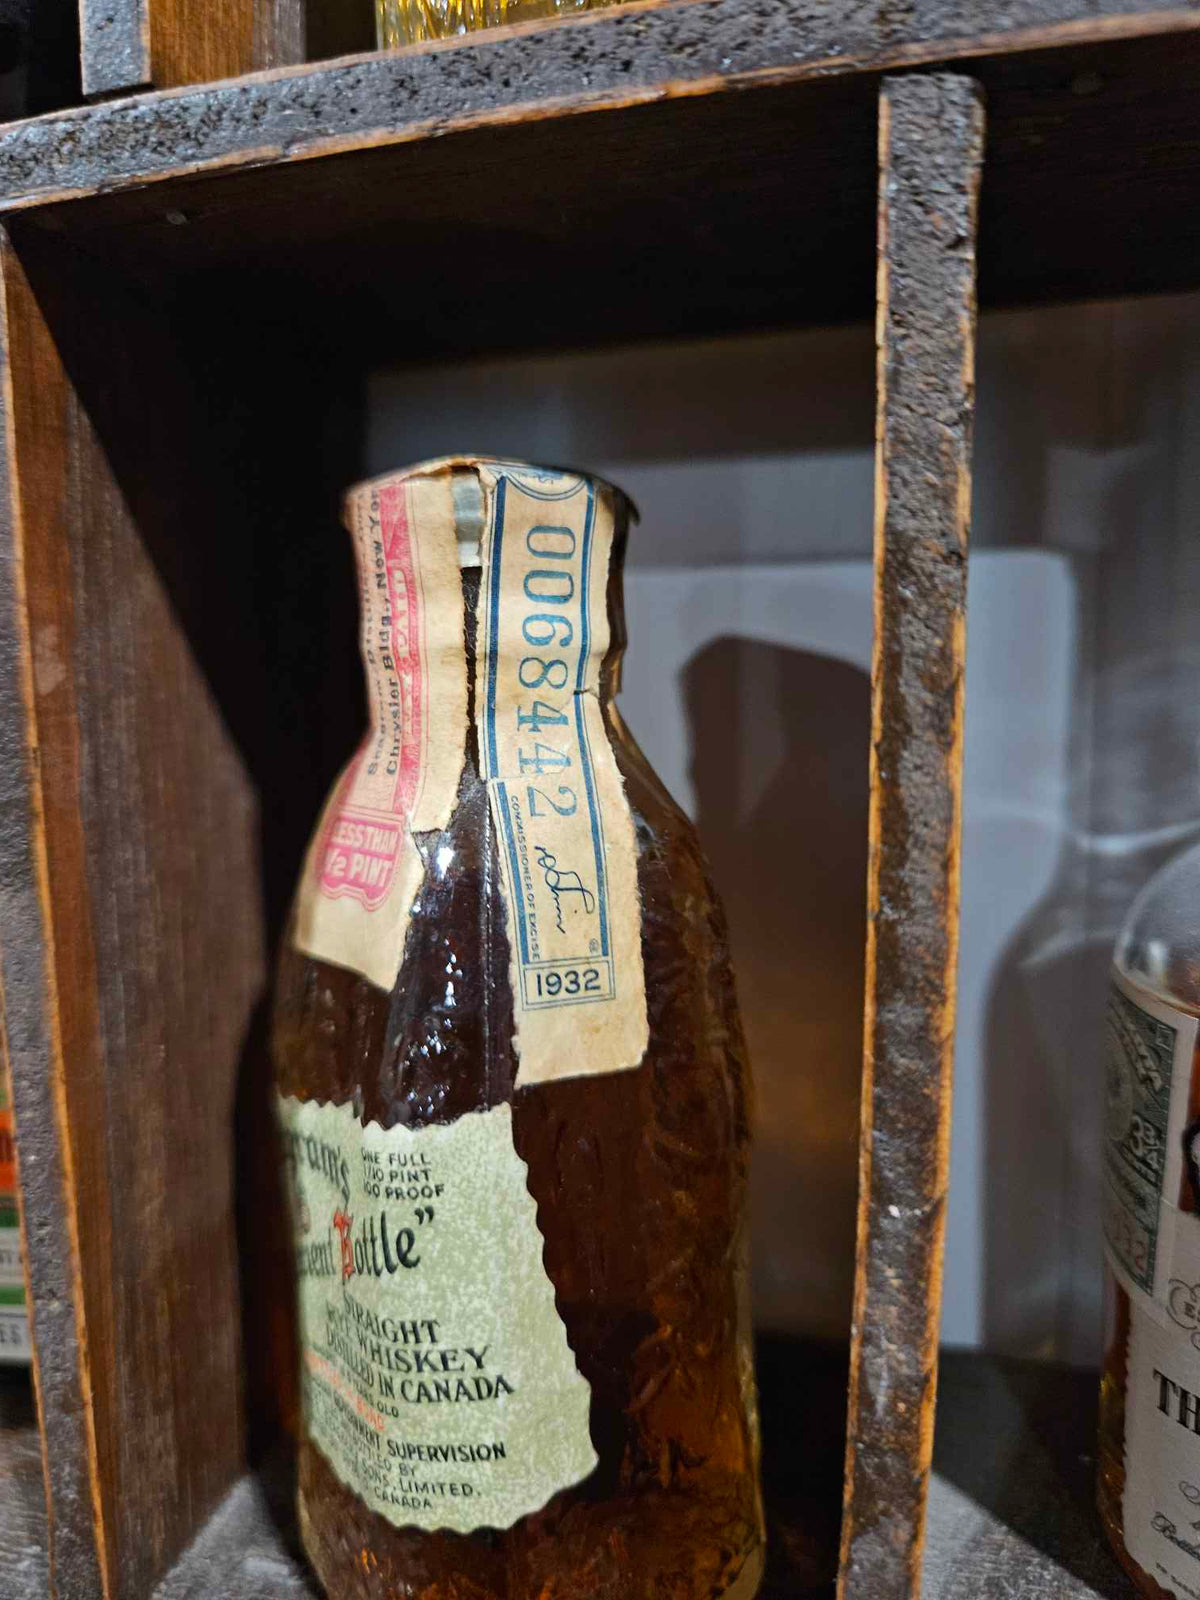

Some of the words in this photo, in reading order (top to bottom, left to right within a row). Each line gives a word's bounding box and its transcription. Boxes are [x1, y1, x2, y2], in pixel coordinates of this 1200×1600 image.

[373, 540, 387, 590] New
[517, 525, 577, 817] 0068442
[511, 795, 532, 891] COMMISSIONER
[350, 852, 394, 888] PINT
[526, 892, 536, 908] OF
[528, 912, 541, 960] EXCISE
[536, 968, 601, 997] 1932
[389, 1153, 433, 1167] FULL
[389, 1169, 432, 1183] PINT
[385, 1183, 445, 1200] PROOF
[343, 1289, 441, 1345] STRAIGHT
[356, 1326, 492, 1374] WHISKEY
[378, 1371, 396, 1400] IN
[400, 1374, 514, 1404] CANADA
[386, 1439, 507, 1464] SUPERVISION
[374, 1486, 433, 1510] CANADA
